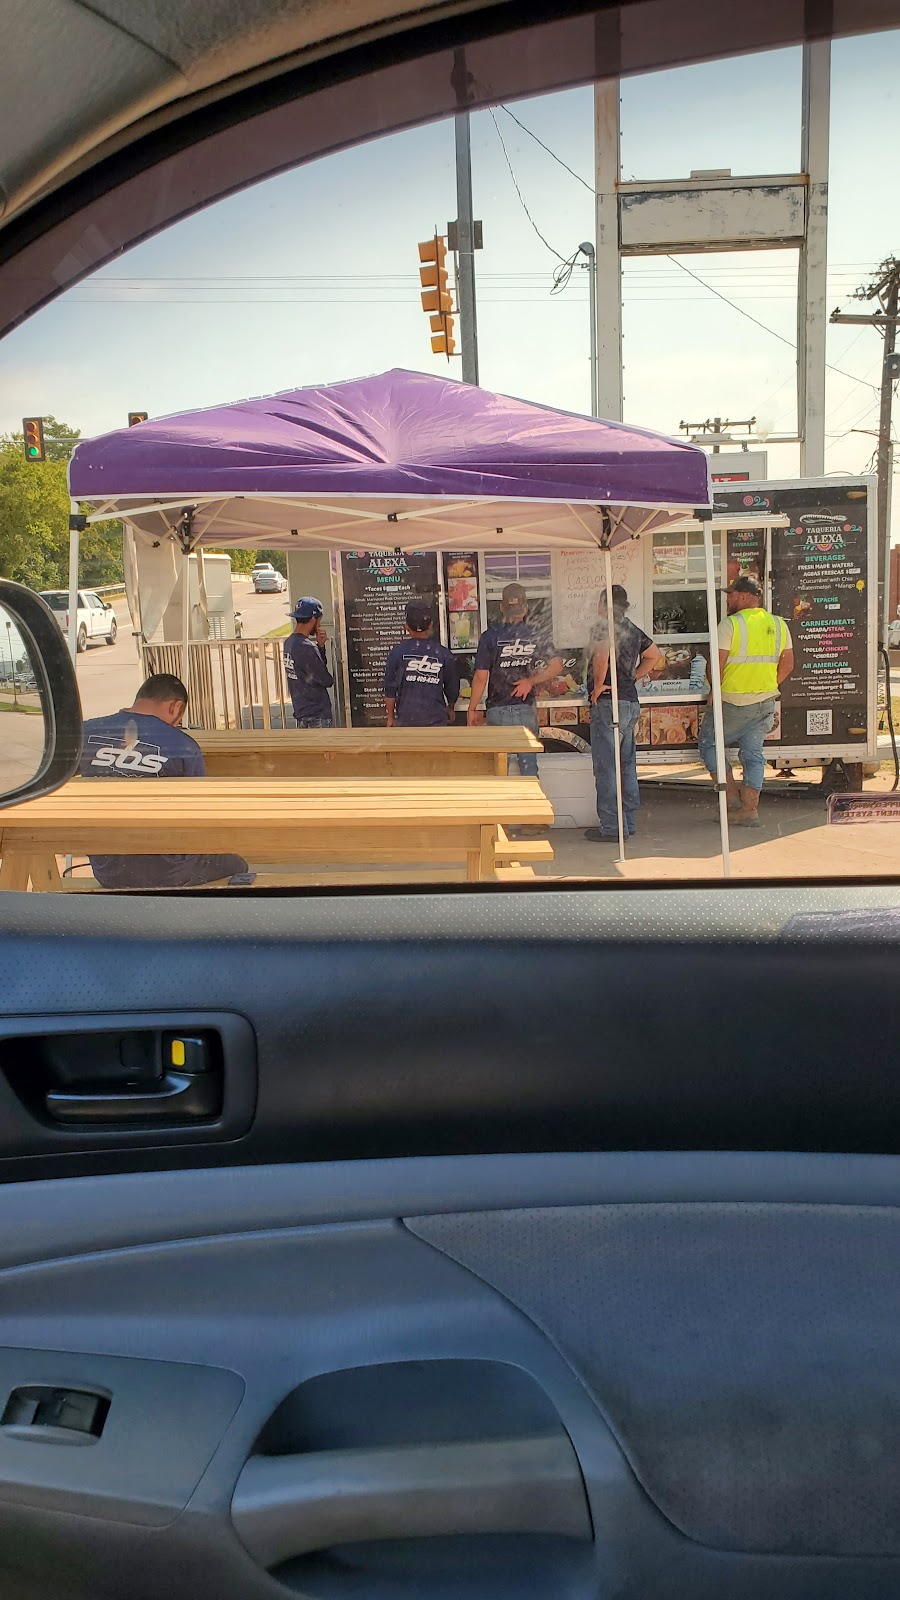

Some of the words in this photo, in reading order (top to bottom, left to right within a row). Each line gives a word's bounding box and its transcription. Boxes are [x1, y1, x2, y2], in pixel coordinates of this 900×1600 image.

[806, 526, 841, 534] TAQUERIA
[806, 534, 843, 544] ALEXA
[805, 554, 846, 562] BEVERAGES
[369, 558, 407, 568] ALEXA
[801, 619, 855, 627] CARNES/MEATS
